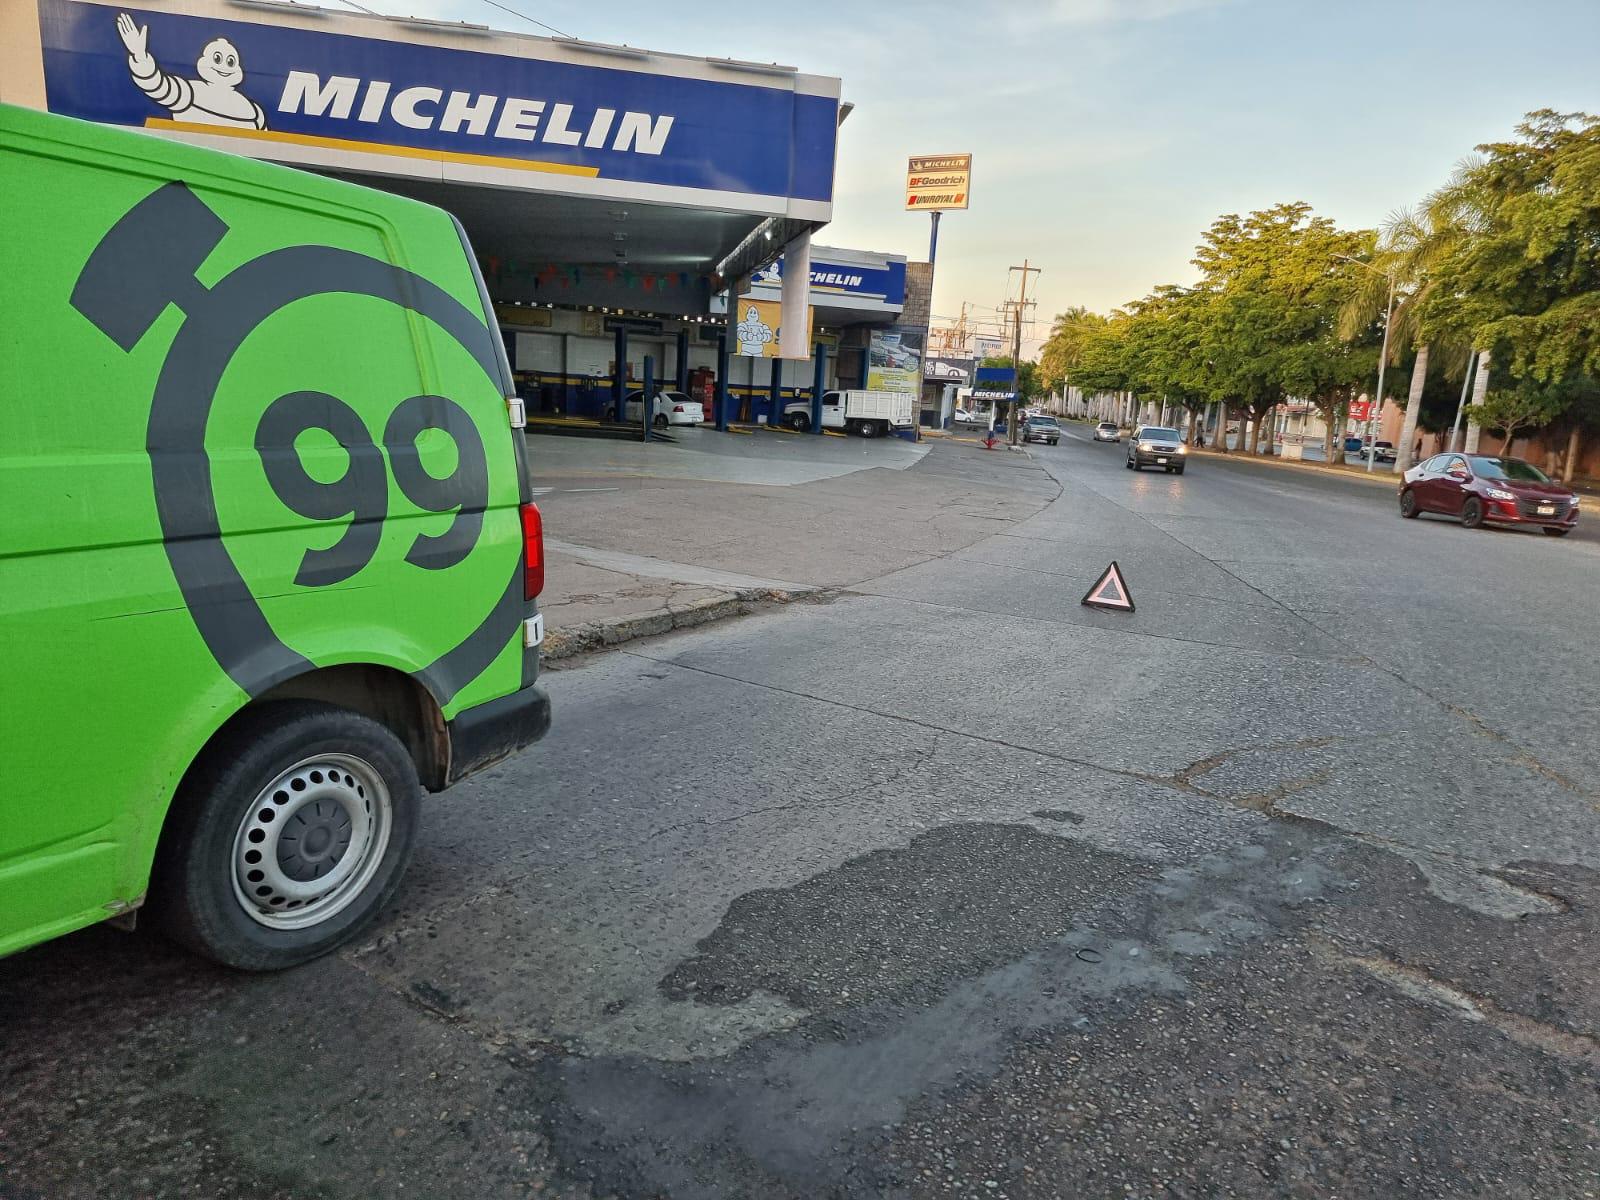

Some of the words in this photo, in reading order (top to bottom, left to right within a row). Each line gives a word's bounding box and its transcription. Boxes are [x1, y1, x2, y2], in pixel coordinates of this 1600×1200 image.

[277, 70, 675, 156] MICHELIN
[924, 160, 966, 168] MICHELIN
[909, 175, 966, 186] BFGoodrich
[916, 194, 954, 204] UNIROYAL
[808, 272, 862, 286] CHELIN
[253, 390, 489, 588] 99
